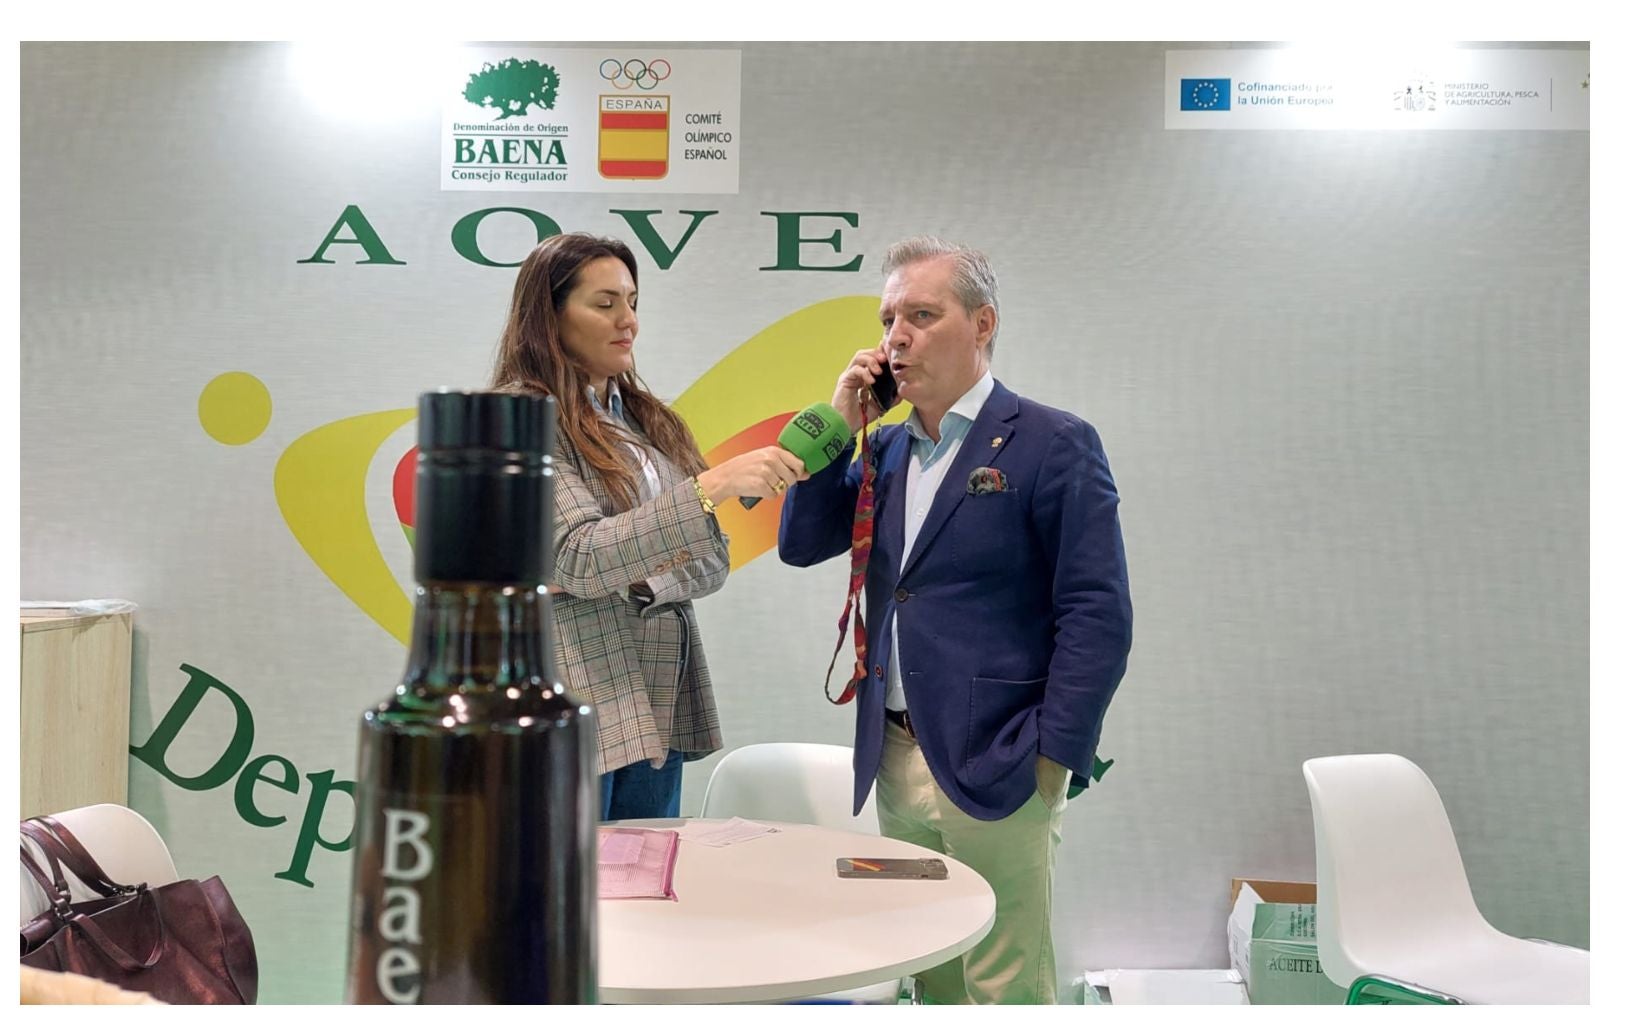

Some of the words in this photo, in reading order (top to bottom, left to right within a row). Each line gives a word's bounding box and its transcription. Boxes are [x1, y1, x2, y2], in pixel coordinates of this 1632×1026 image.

[1237, 81, 1313, 92] Cofinanciado
[606, 98, 663, 110] ESPAÑA
[1237, 95, 1247, 105] la
[1251, 95, 1285, 105] Unión
[685, 111, 722, 125] COMITÉ
[453, 122, 520, 133] Denominación
[523, 123, 535, 133] de
[684, 128, 732, 143] OLÍMPICO
[454, 139, 568, 165] BAENA
[684, 146, 727, 160] ESPAÑOL
[451, 169, 501, 182] Consejo
[505, 170, 569, 184] Regulador
[296, 204, 865, 273] AOVE
[129, 662, 358, 888] Dep
[1268, 957, 1313, 973] ACEITE
